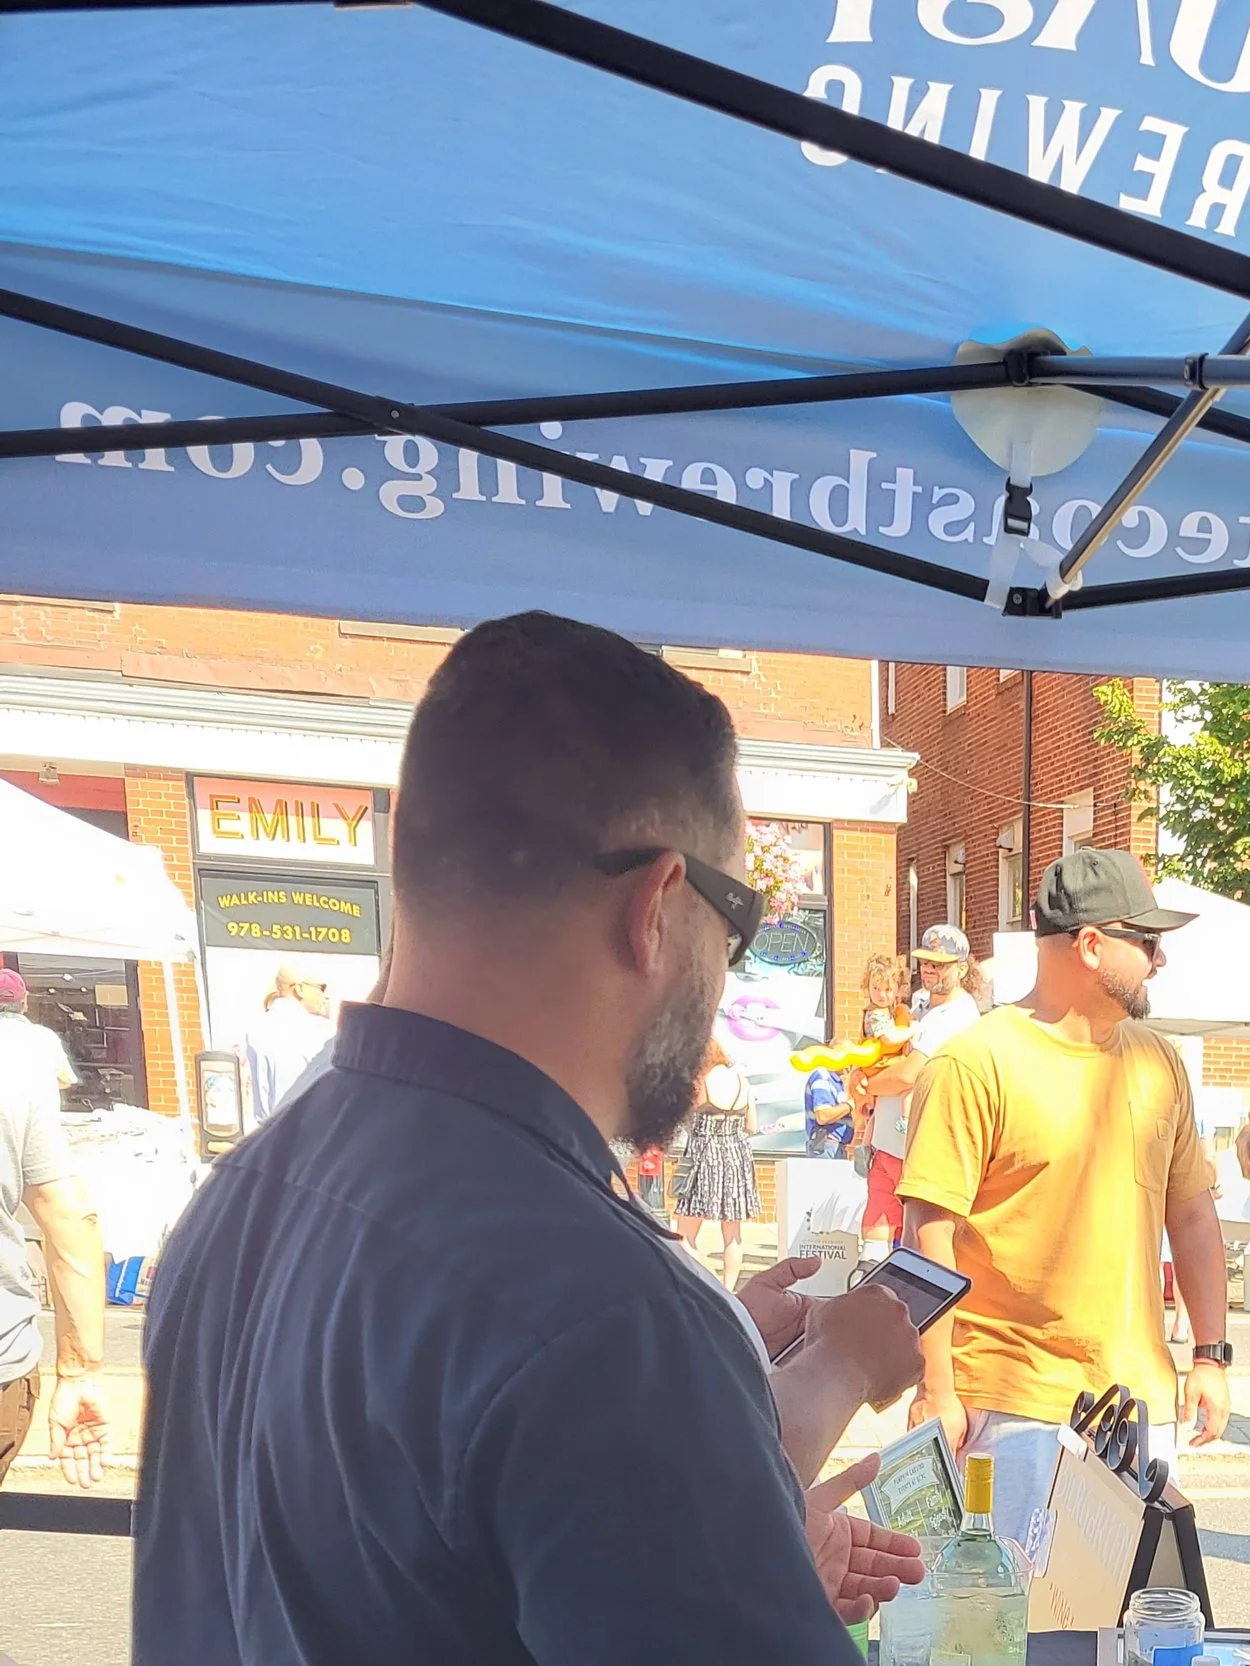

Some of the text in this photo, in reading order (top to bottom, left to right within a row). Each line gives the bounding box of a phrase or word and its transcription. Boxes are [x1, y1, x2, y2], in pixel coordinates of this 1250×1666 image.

[209, 794, 368, 846] EMILY
[218, 891, 361, 917] WALK-INS WELCOME
[227, 921, 351, 944] 978-531-1708
[753, 931, 809, 953] OPEN
[799, 1250, 847, 1260] FESTIVAL
